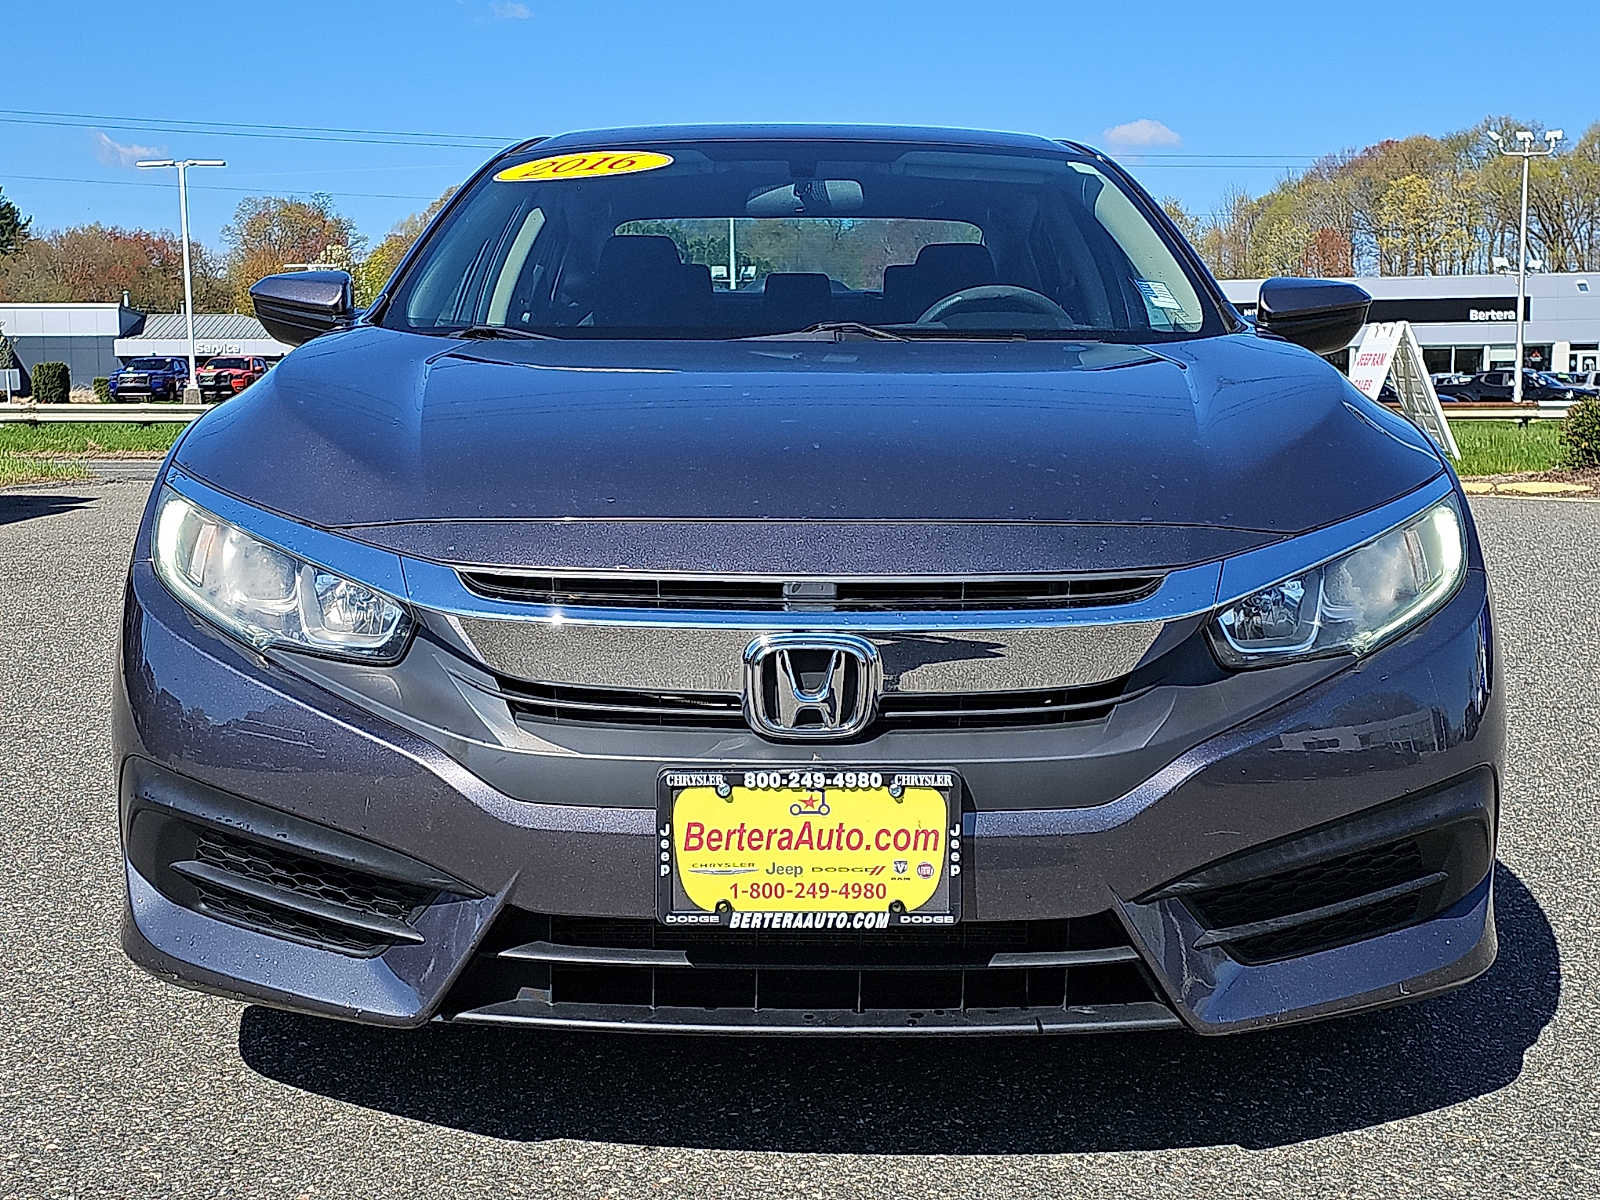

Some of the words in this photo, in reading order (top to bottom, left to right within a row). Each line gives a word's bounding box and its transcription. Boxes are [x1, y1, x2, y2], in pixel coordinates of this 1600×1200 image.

[519, 155, 647, 178] 2016
[1470, 309, 1516, 320] Bertera
[196, 342, 241, 354] Service
[666, 774, 724, 787] CHRYSLER
[743, 772, 882, 788] 800-249-4980
[894, 774, 953, 787] CHRYSLER
[684, 820, 940, 851] BerteraAuto.com
[660, 823, 670, 877] Jeep
[950, 823, 960, 877] Jeep
[766, 862, 803, 877] Jeep
[729, 882, 887, 899] 1-800-249-4980
[666, 915, 720, 923] DODGE
[729, 912, 890, 929] BERTERAAUTO.COM
[900, 915, 954, 924] DODGE
